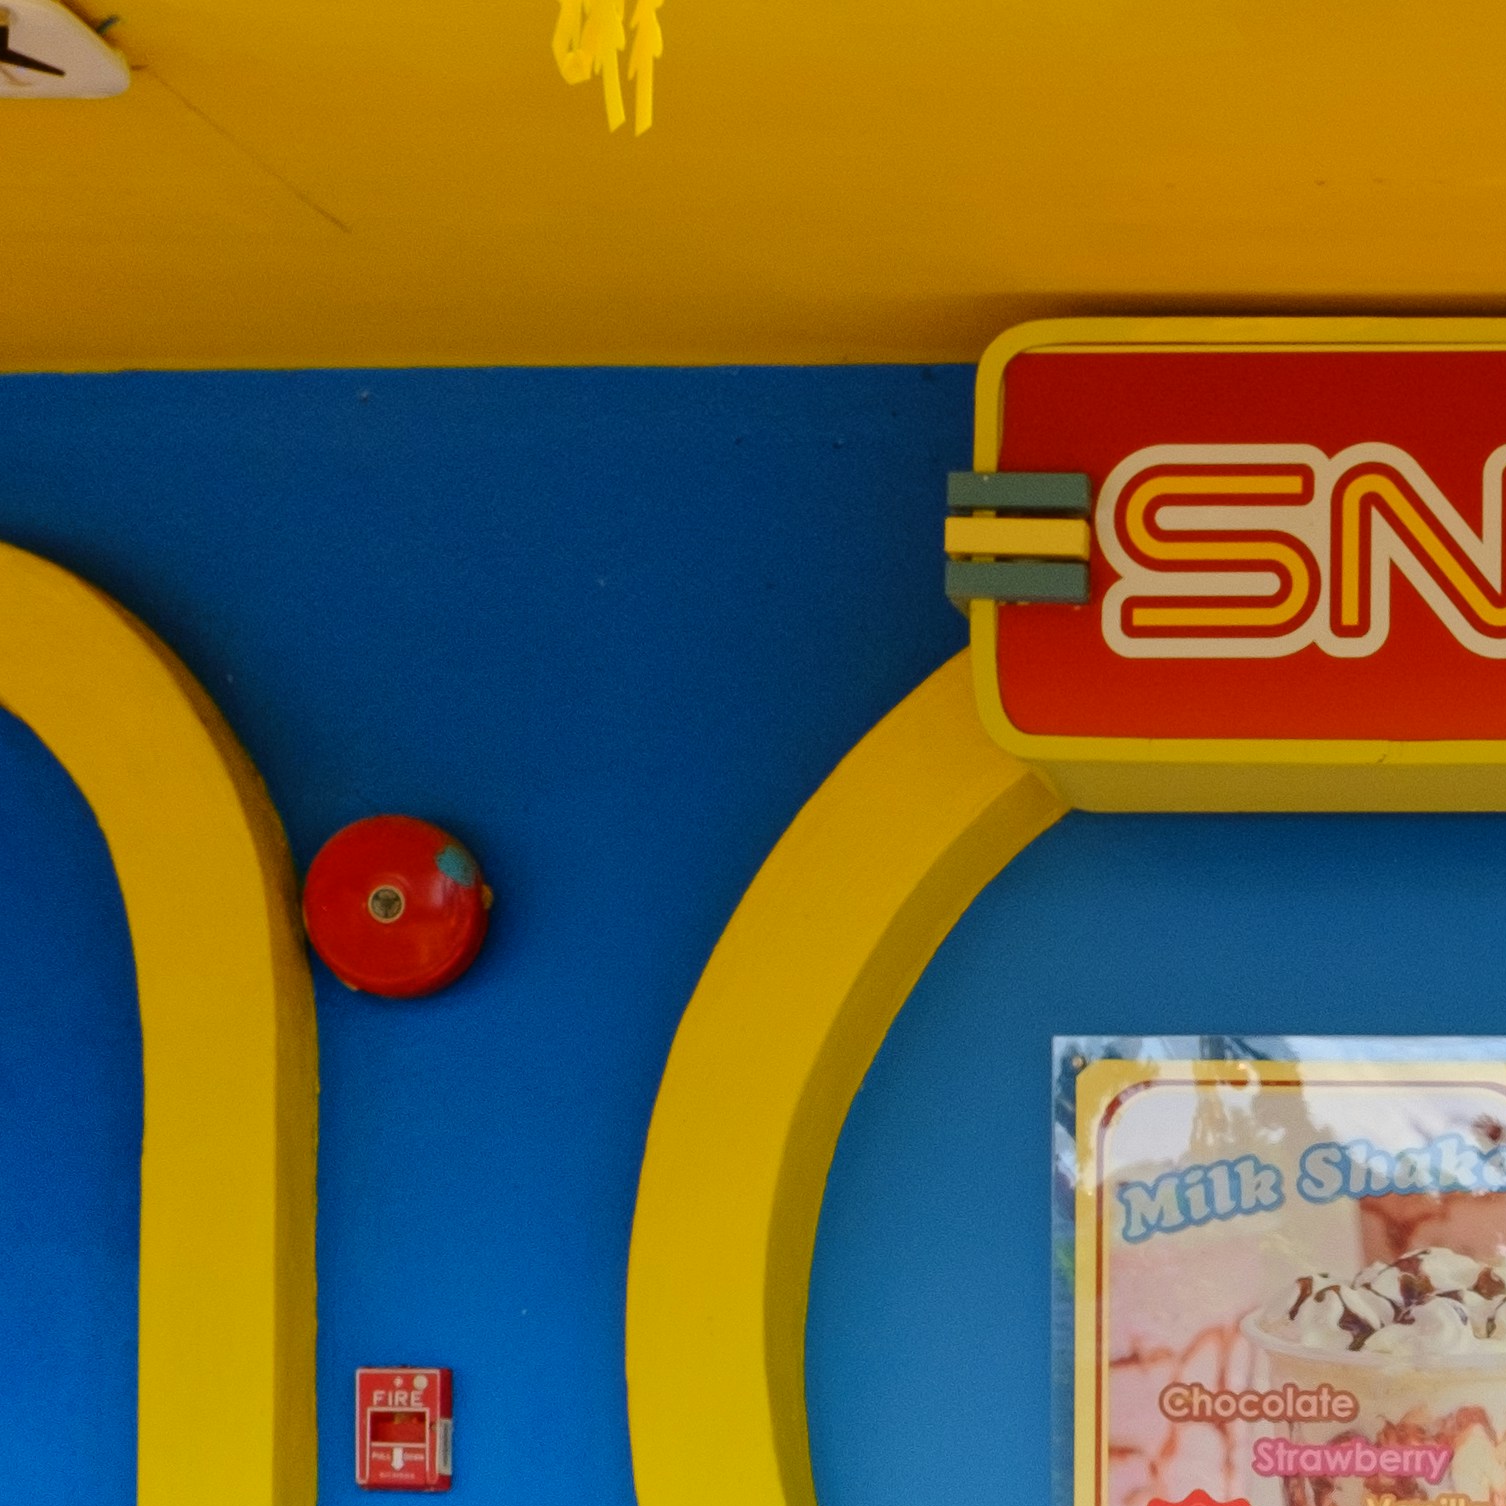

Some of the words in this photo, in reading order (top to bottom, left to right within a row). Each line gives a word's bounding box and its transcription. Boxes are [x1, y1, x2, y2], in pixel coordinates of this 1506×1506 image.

[1119, 1157, 1283, 1242] Milk
[372, 1389, 424, 1407] FIRE
[1163, 1385, 1355, 1419] Chocolate
[1254, 1442, 1451, 1481] Strawberry
